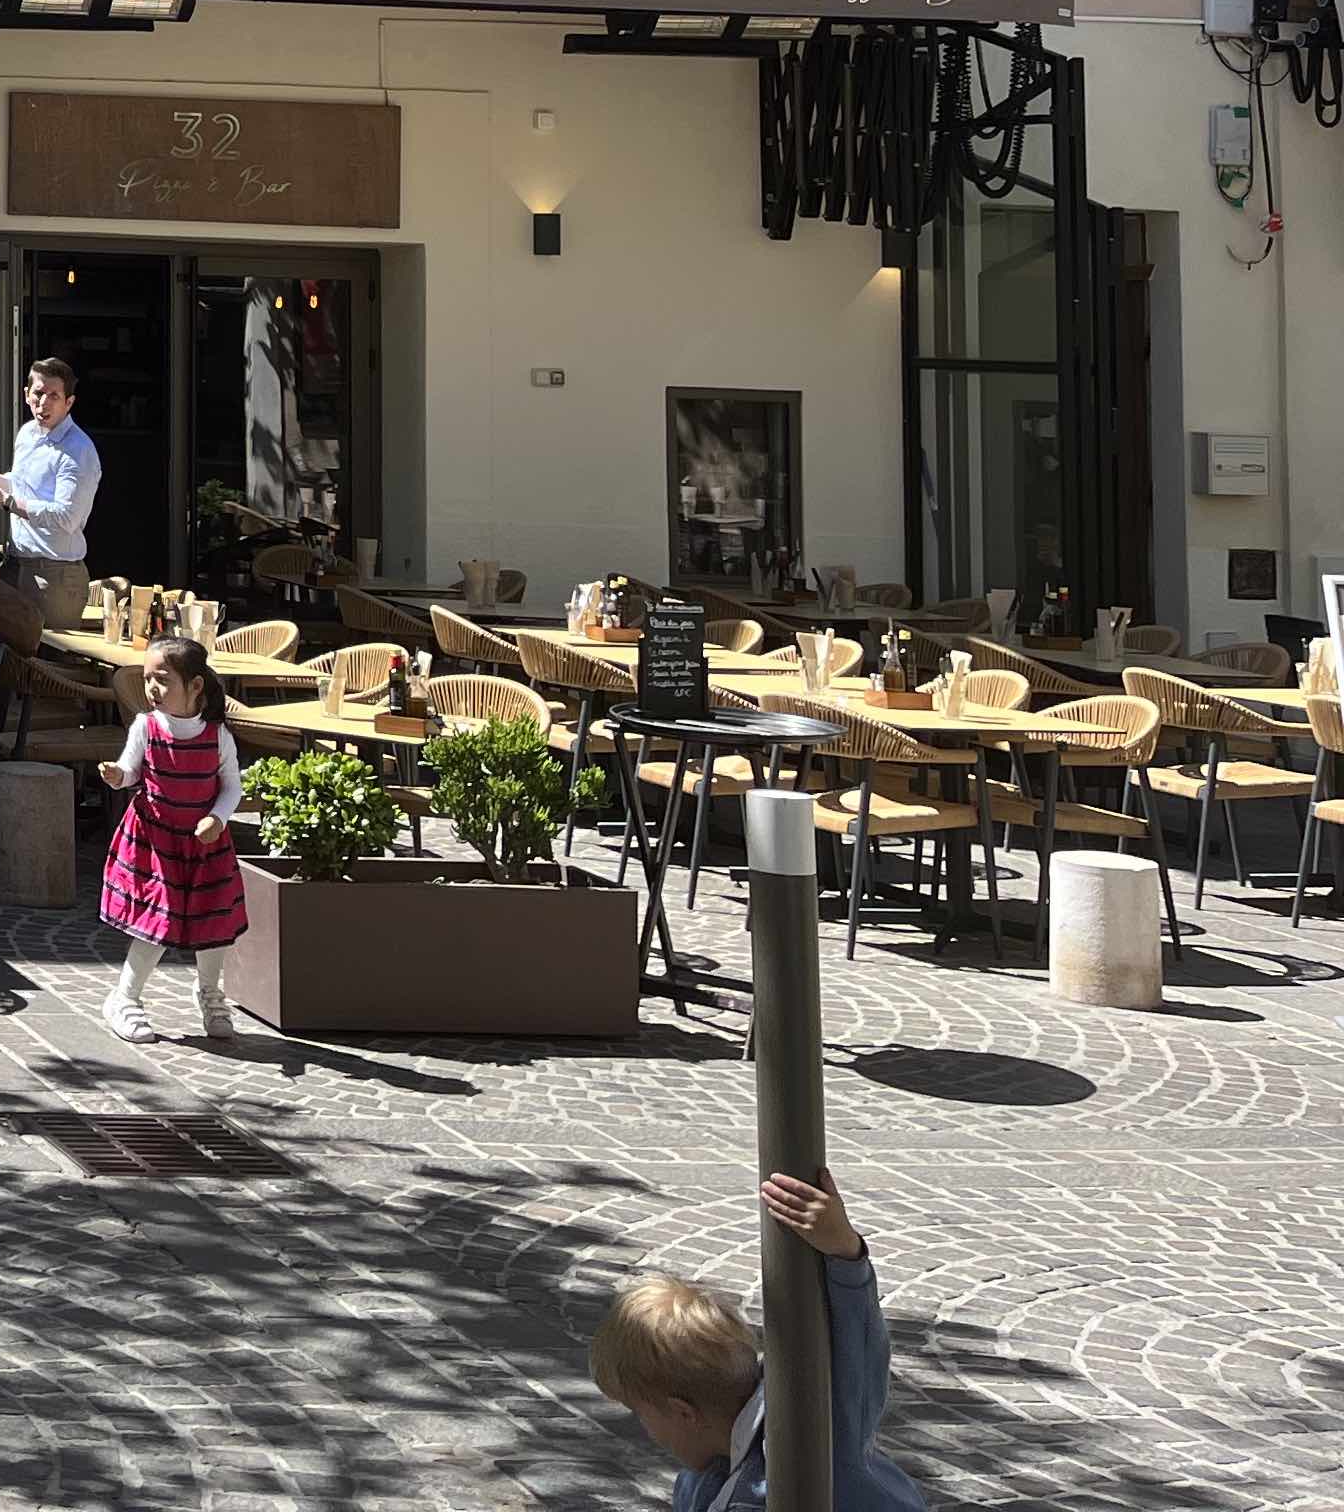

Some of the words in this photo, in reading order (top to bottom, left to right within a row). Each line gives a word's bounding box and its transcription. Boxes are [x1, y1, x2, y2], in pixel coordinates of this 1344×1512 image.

[169, 111, 241, 160] 32
[118, 158, 192, 203] Pizza
[234, 163, 292, 207] Bar
